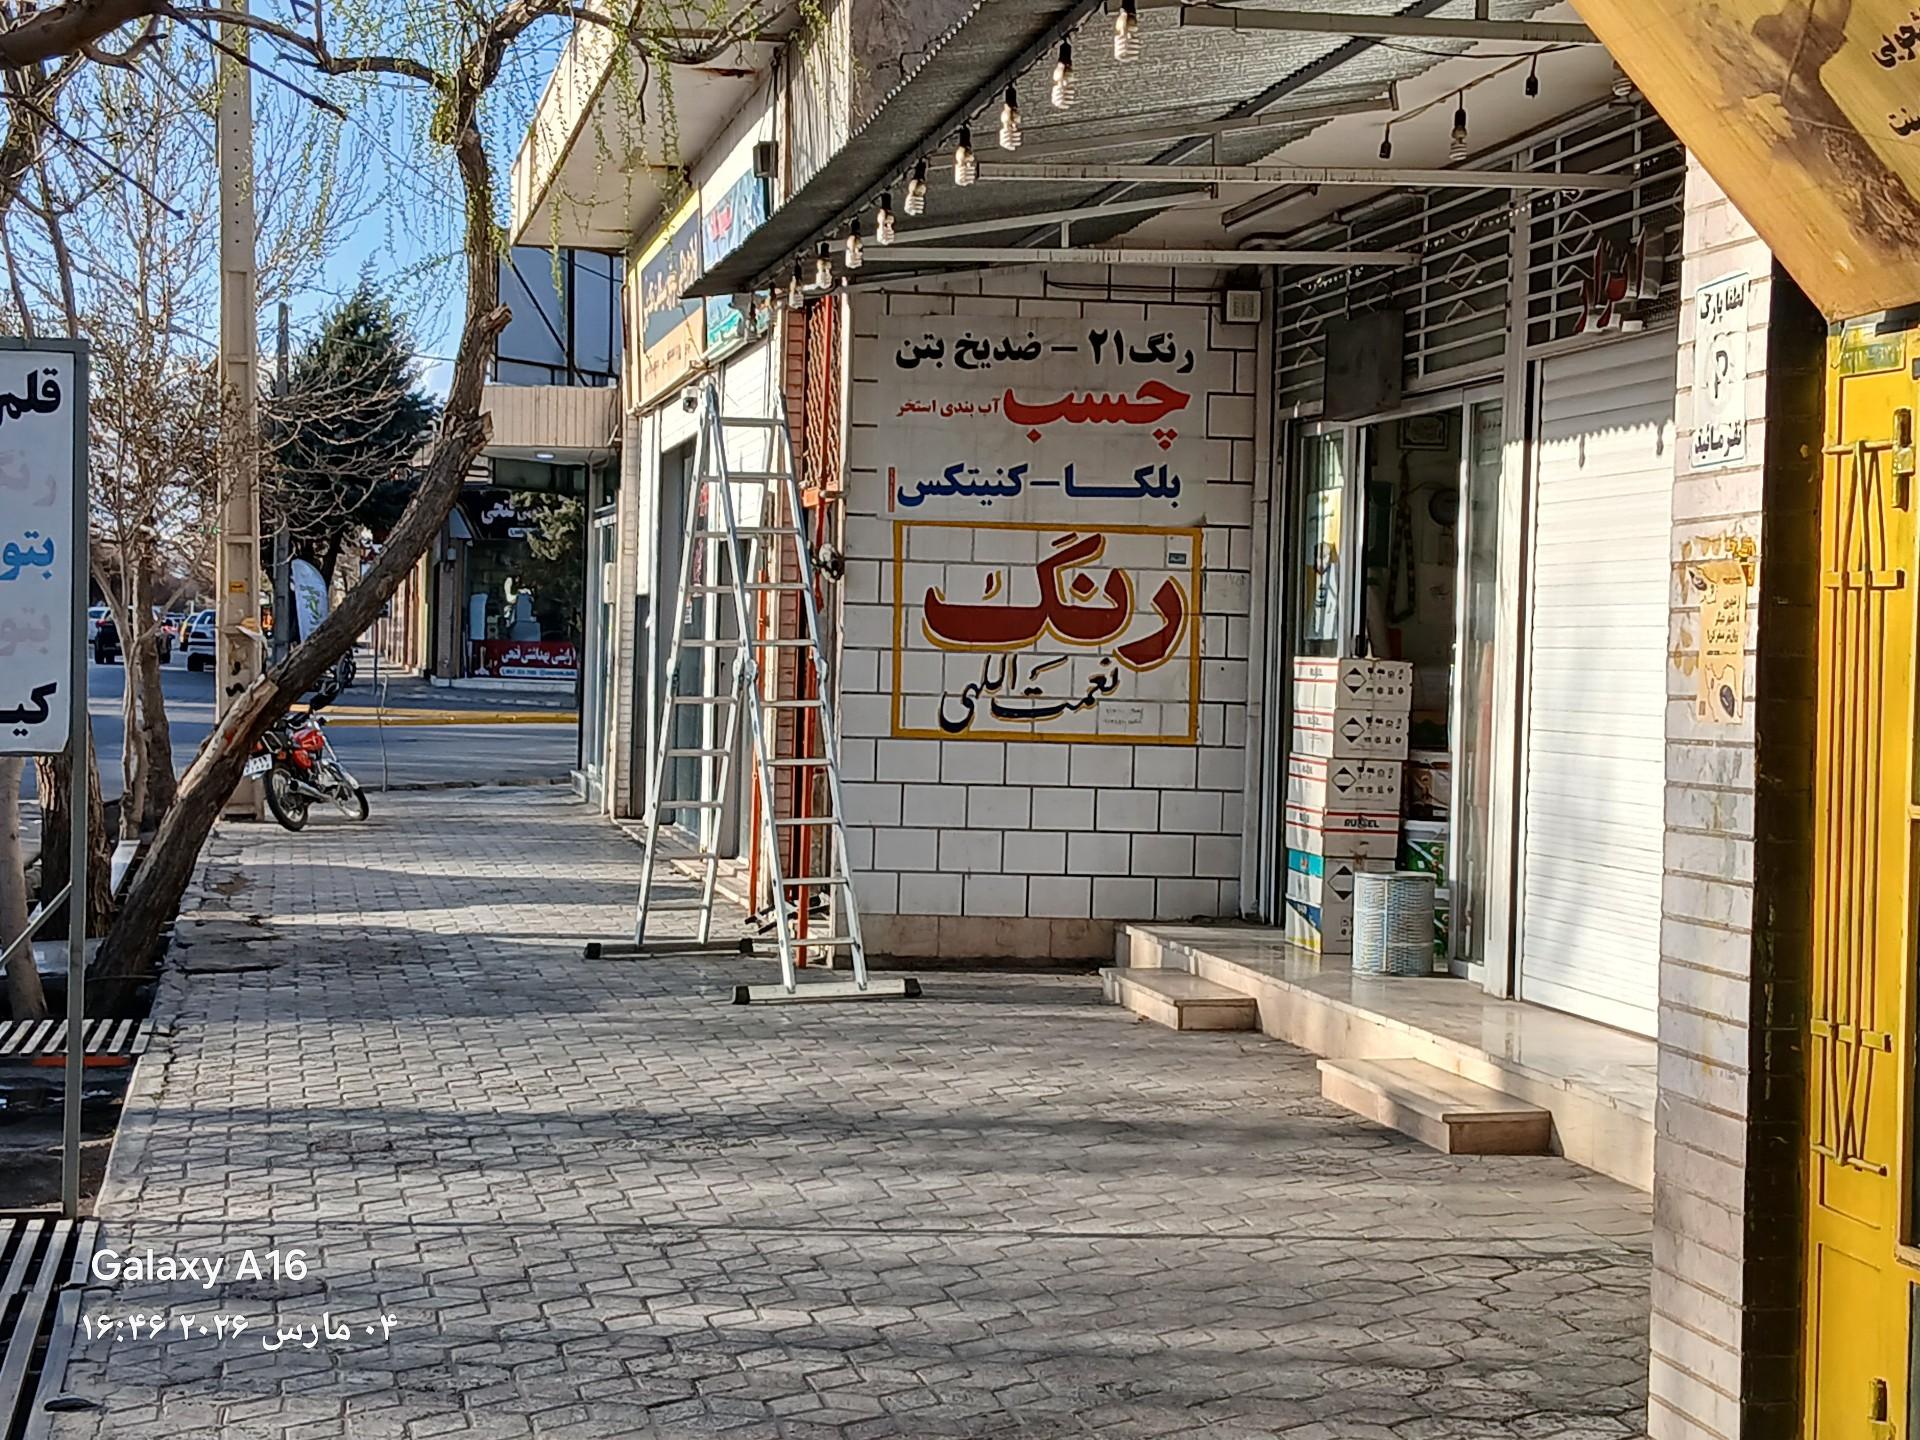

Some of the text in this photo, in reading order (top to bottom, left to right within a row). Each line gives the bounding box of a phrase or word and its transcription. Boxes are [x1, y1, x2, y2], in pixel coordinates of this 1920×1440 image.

[1726, 281, 1745, 311] لطفا
[895, 333, 945, 369] بتن
[953, 329, 1042, 369] ضدیخ
[1088, 328, 1124, 366] ۲۱
[1128, 331, 1195, 373] رنگ
[896, 397, 1000, 418] آب بندی استخر
[1003, 379, 1191, 451] چسب
[896, 463, 1029, 507] کنیتکس
[1064, 463, 1181, 508] بلکا
[922, 531, 1189, 672] رنگ
